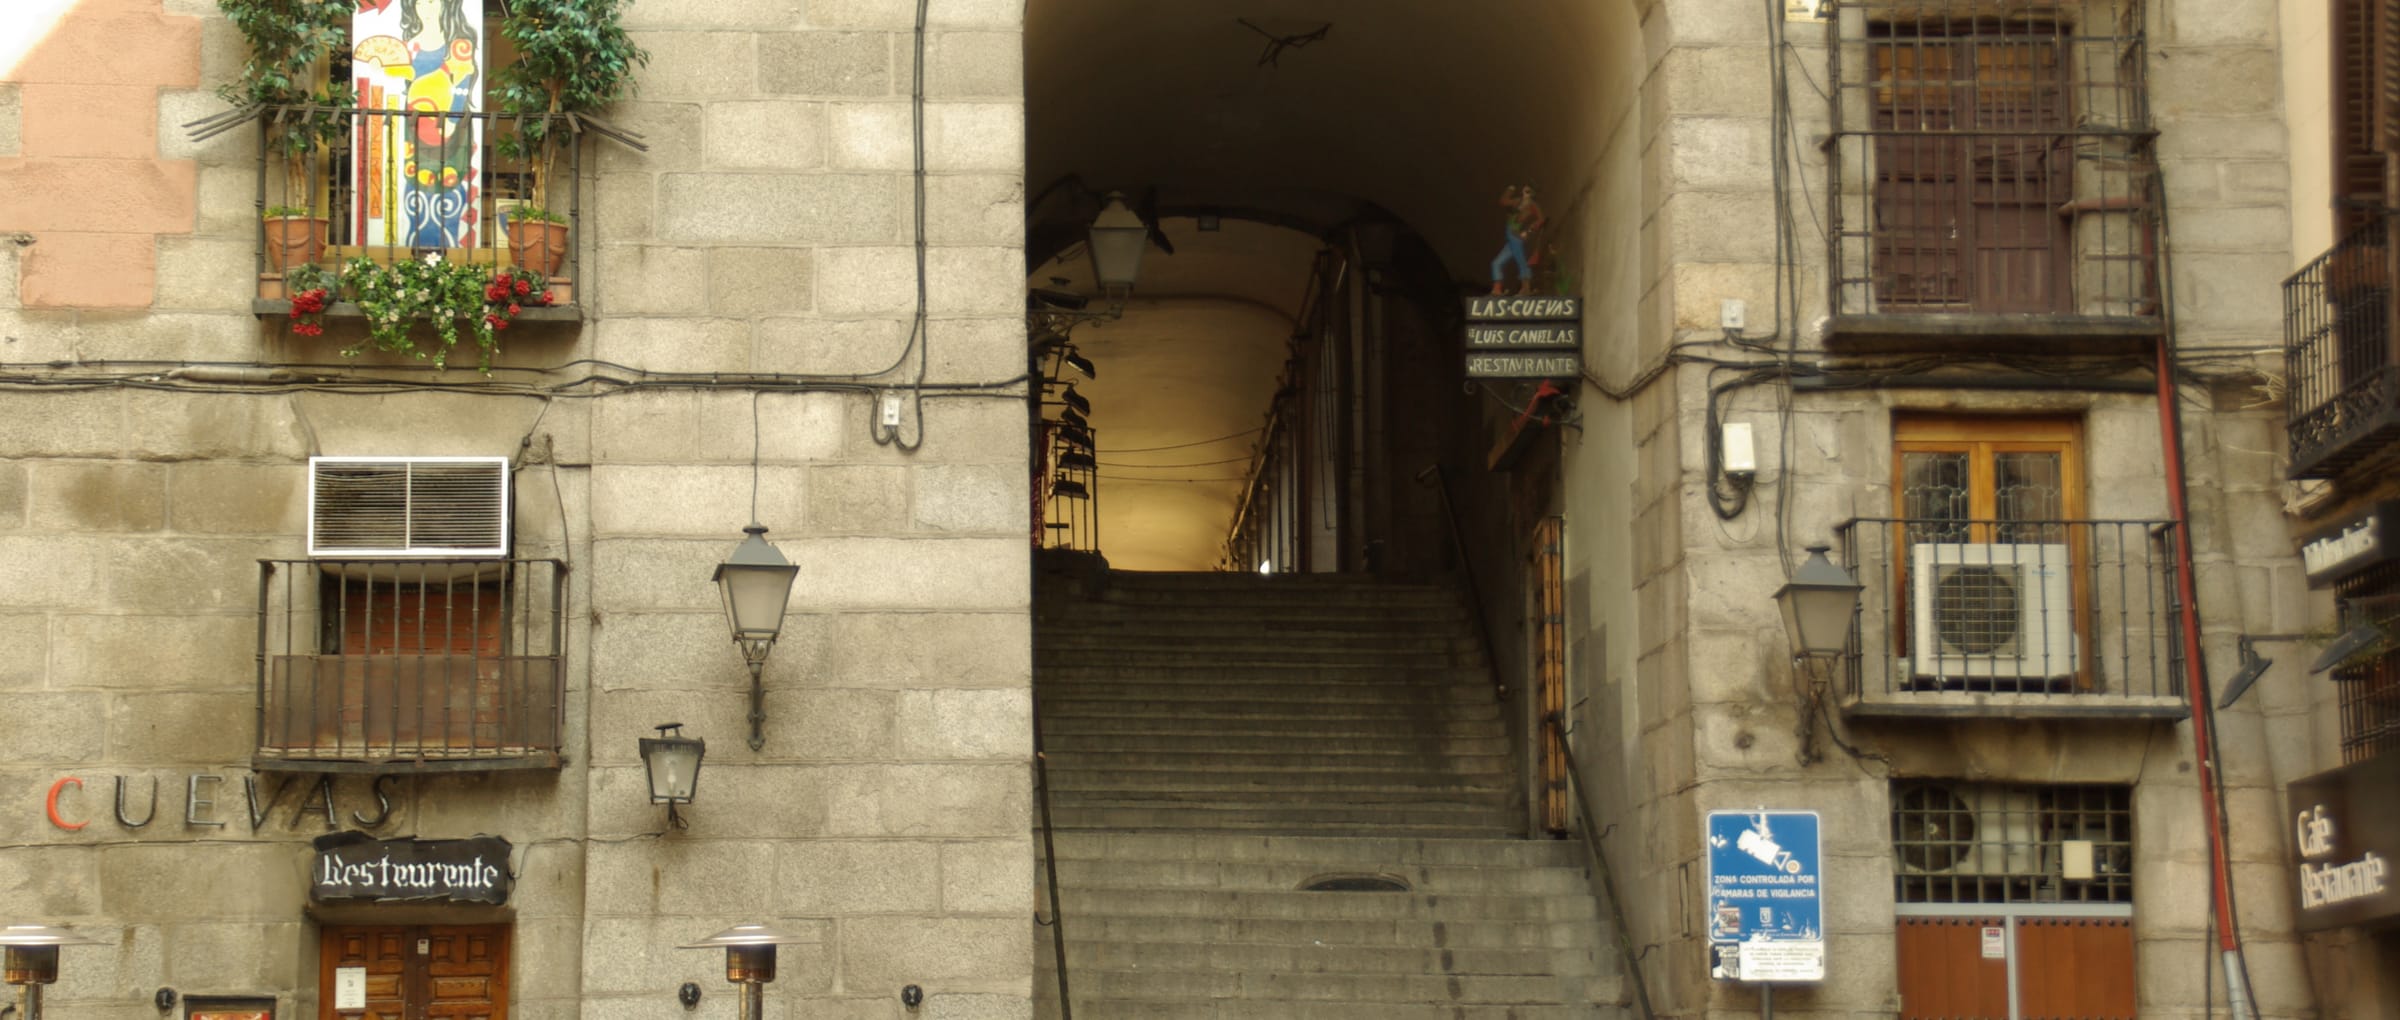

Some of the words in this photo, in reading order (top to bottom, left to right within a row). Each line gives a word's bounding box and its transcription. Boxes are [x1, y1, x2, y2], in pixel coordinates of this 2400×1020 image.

[46, 774, 399, 831] CUEVAS
[1714, 875, 1737, 884] ZONA
[1740, 875, 1795, 884] CONTROLADA
[1797, 875, 1815, 884] POR
[1756, 889, 1769, 898] DE
[1771, 889, 1816, 898] VIGILANCIA
[2300, 851, 2386, 909] Restaurante
